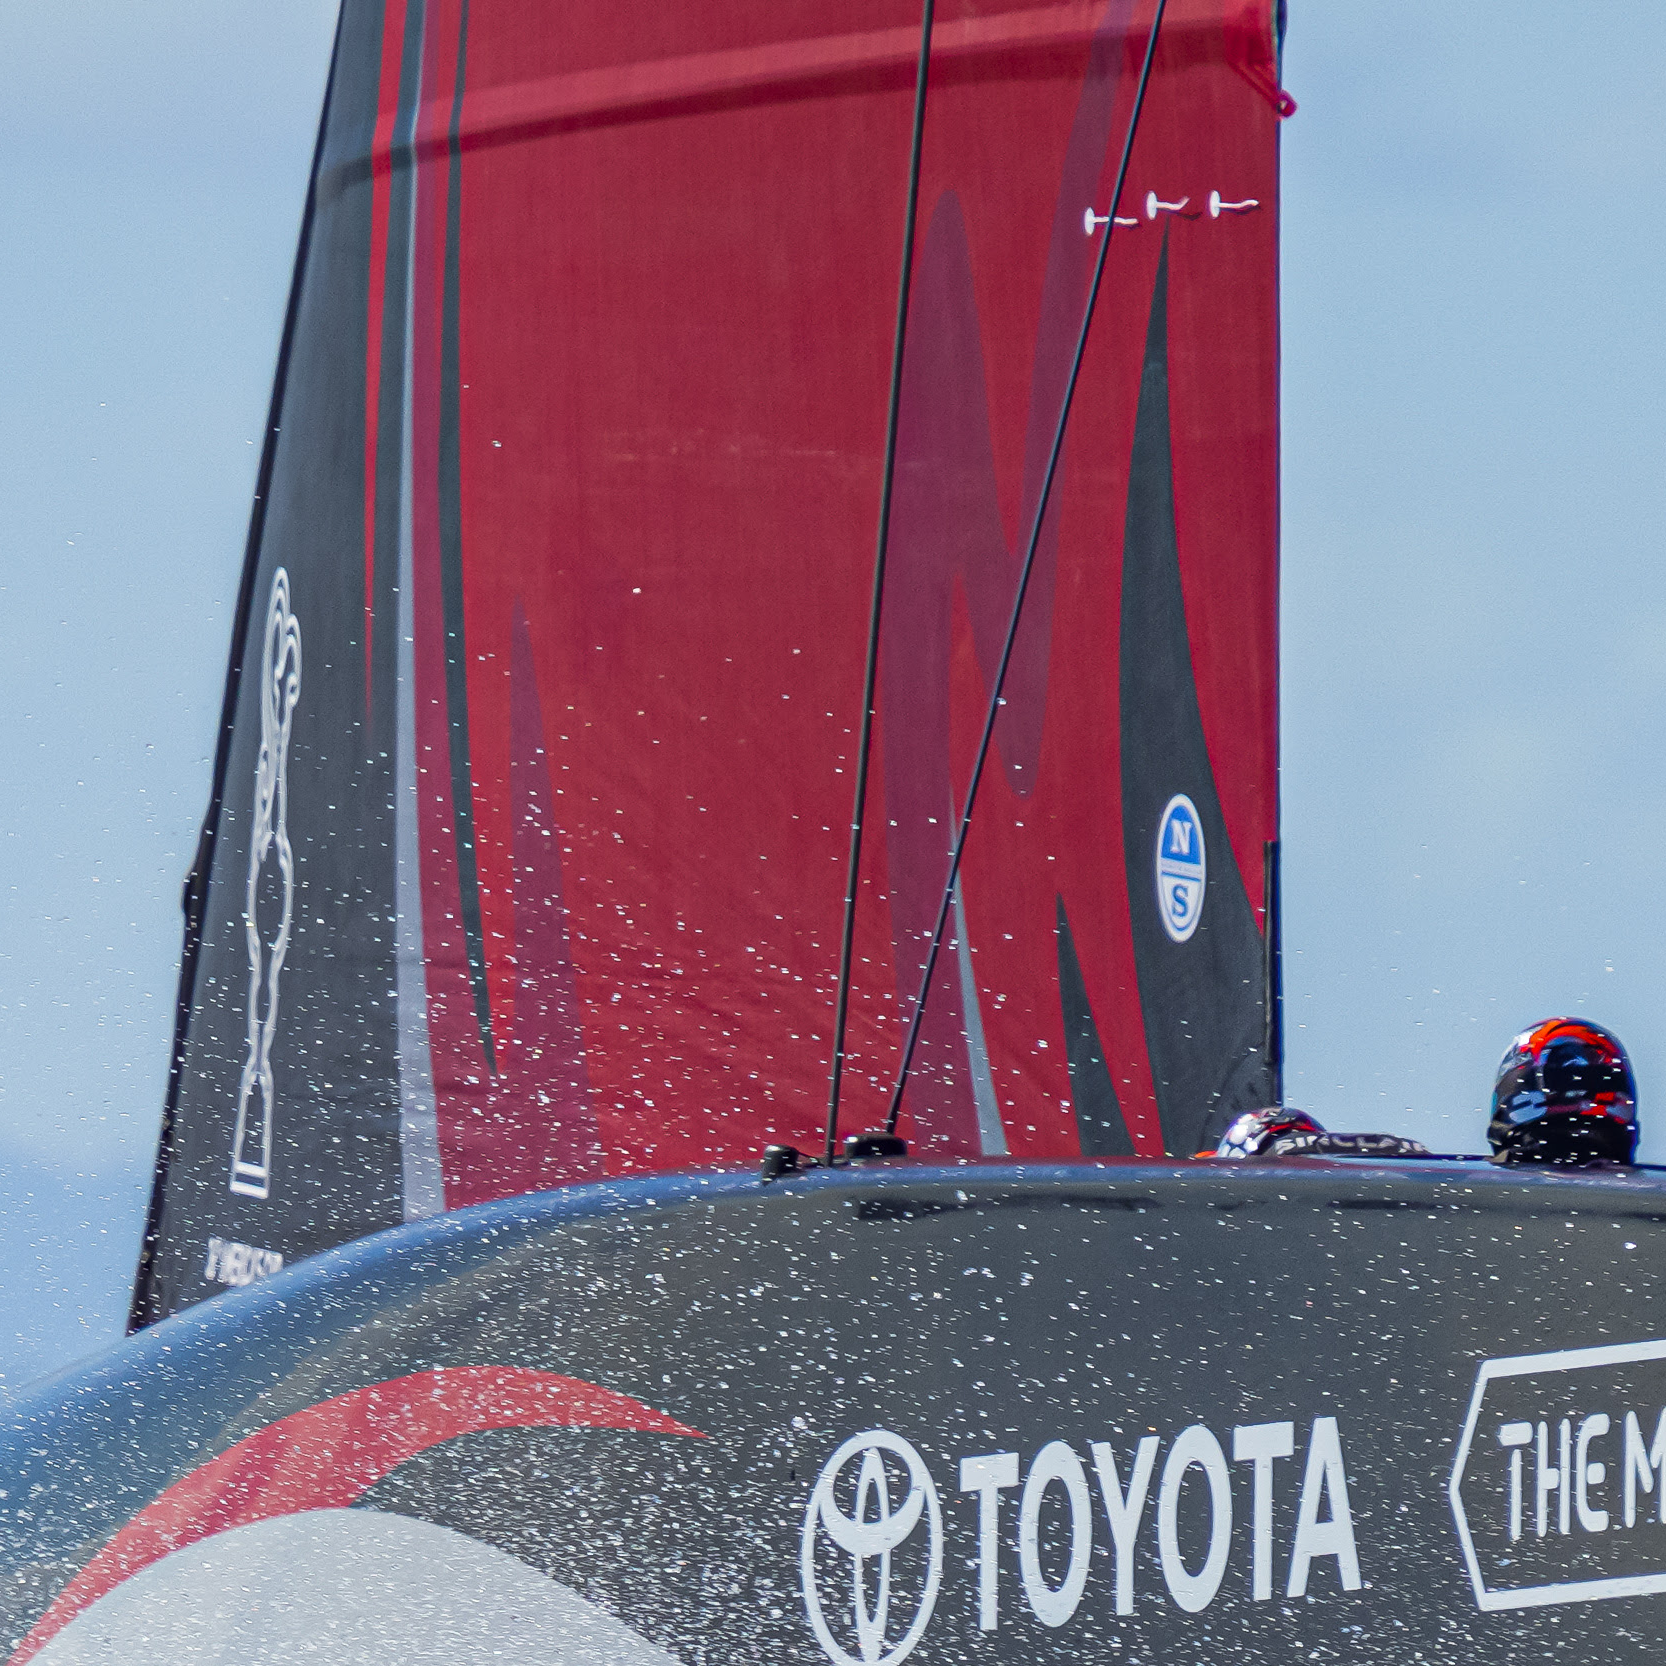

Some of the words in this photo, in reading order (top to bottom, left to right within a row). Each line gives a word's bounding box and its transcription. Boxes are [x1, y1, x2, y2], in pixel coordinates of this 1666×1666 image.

[1169, 817, 1193, 856] N
[1171, 883, 1189, 918] S
[959, 1416, 1363, 1631] TOYOTA
